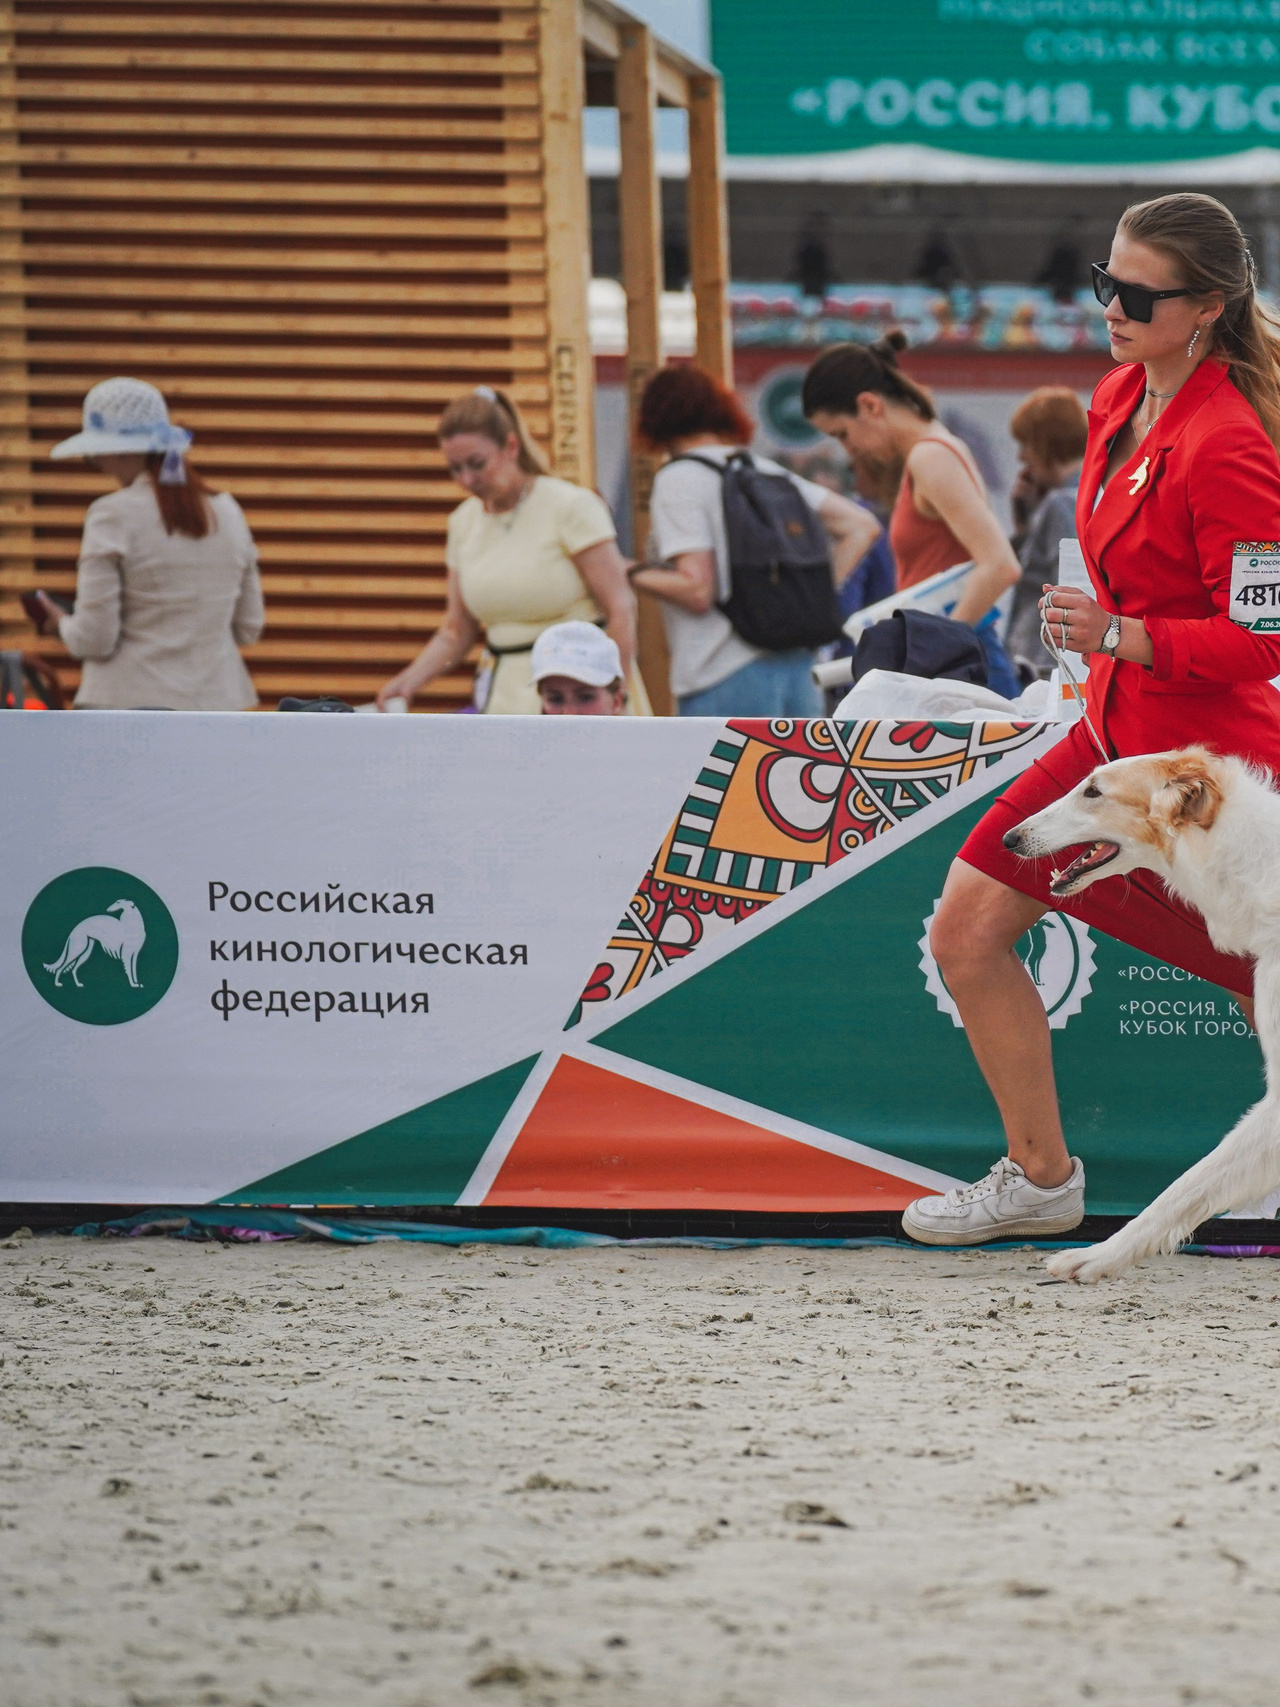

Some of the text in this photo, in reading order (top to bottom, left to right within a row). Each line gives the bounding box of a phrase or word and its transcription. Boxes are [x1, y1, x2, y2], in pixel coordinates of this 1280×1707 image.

[1024, 29, 1167, 65] СОБАК
[791, 77, 1111, 131] «РОССИЯ.
[208, 881, 435, 915] Российская
[209, 939, 529, 966] кинологическая
[210, 978, 430, 1021] федерация
[1119, 1000, 1221, 1016] «РОССИЯ.
[1120, 1020, 1187, 1036] КУБОК
